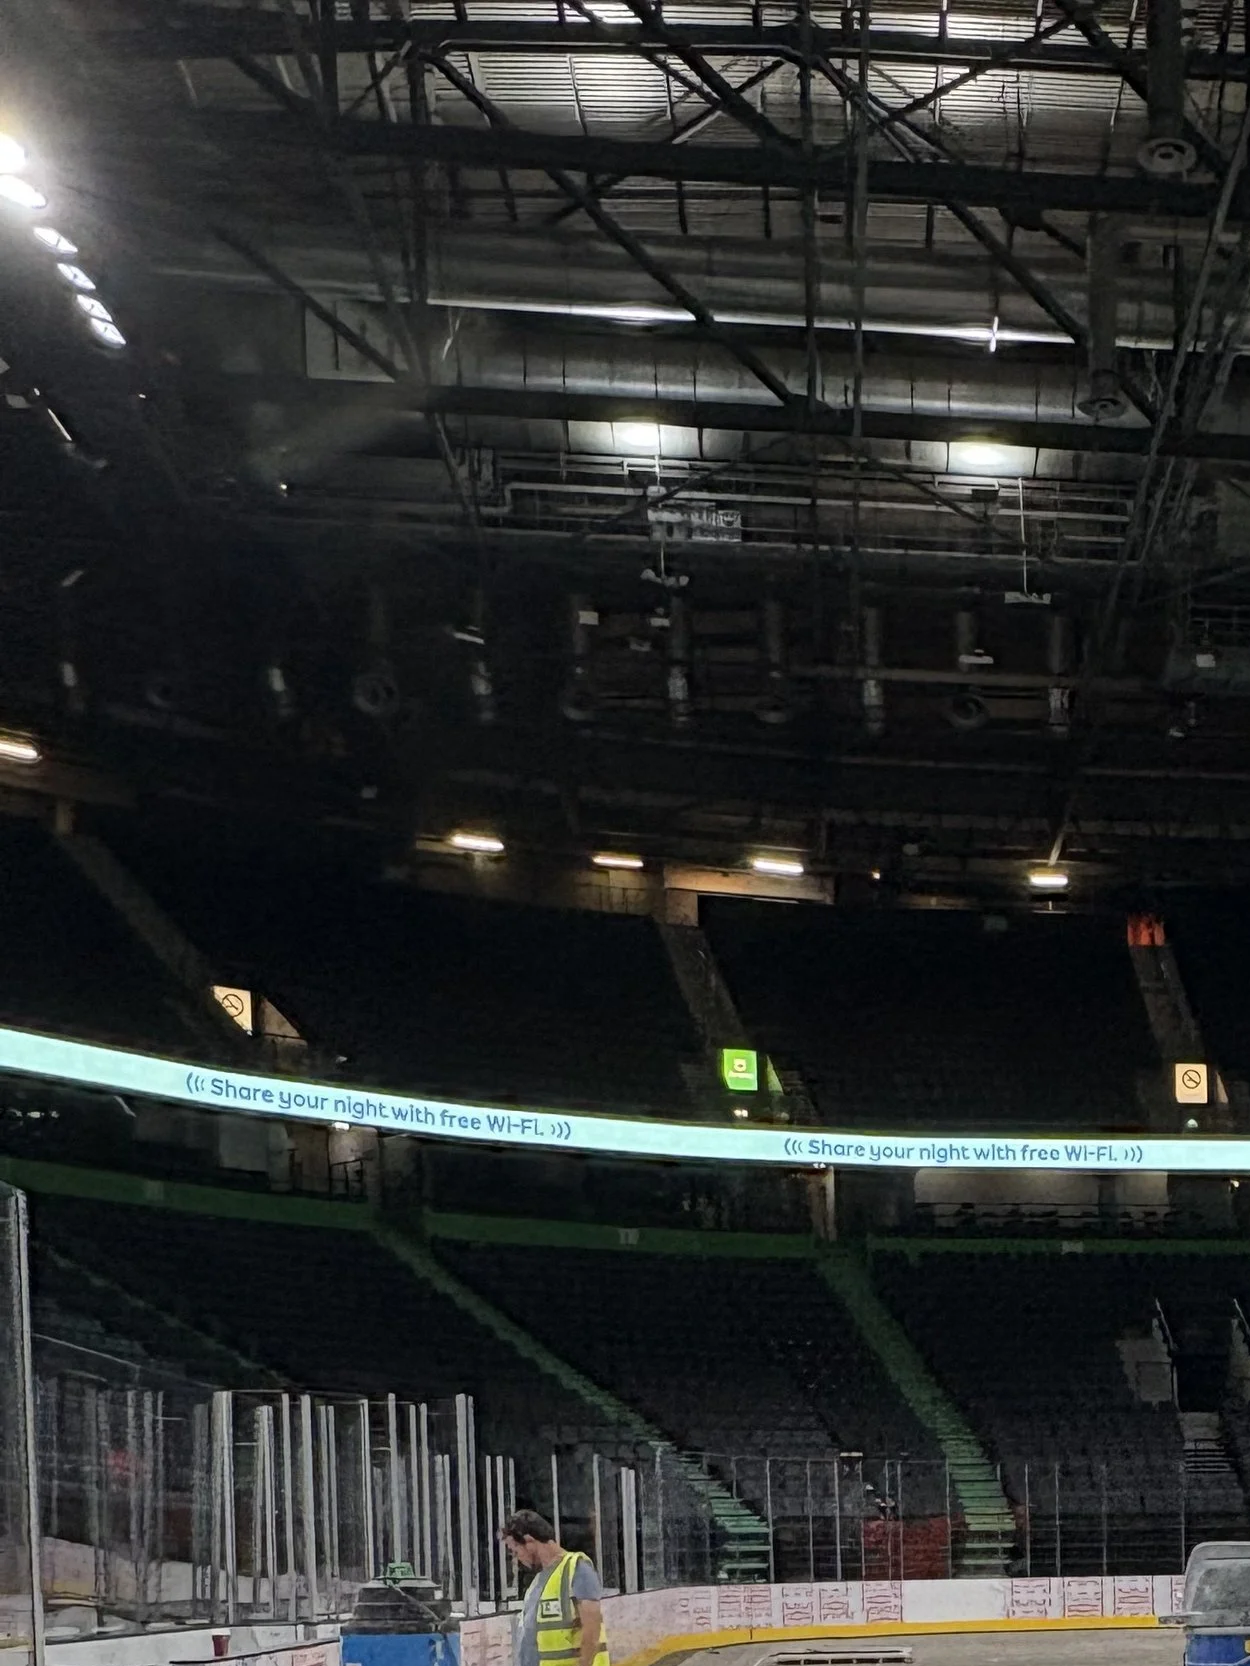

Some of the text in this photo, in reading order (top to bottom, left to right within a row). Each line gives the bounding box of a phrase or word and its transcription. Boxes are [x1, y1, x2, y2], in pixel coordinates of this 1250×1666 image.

[210, 1077, 274, 1103] Share
[278, 1092, 328, 1109] your
[334, 1096, 388, 1119] night
[392, 1104, 435, 1125] with
[440, 1109, 481, 1130] free
[808, 1139, 865, 1157] Share
[870, 1145, 915, 1161] your
[919, 1144, 970, 1163] night
[973, 1144, 1016, 1161] with
[1021, 1144, 1060, 1161] free
